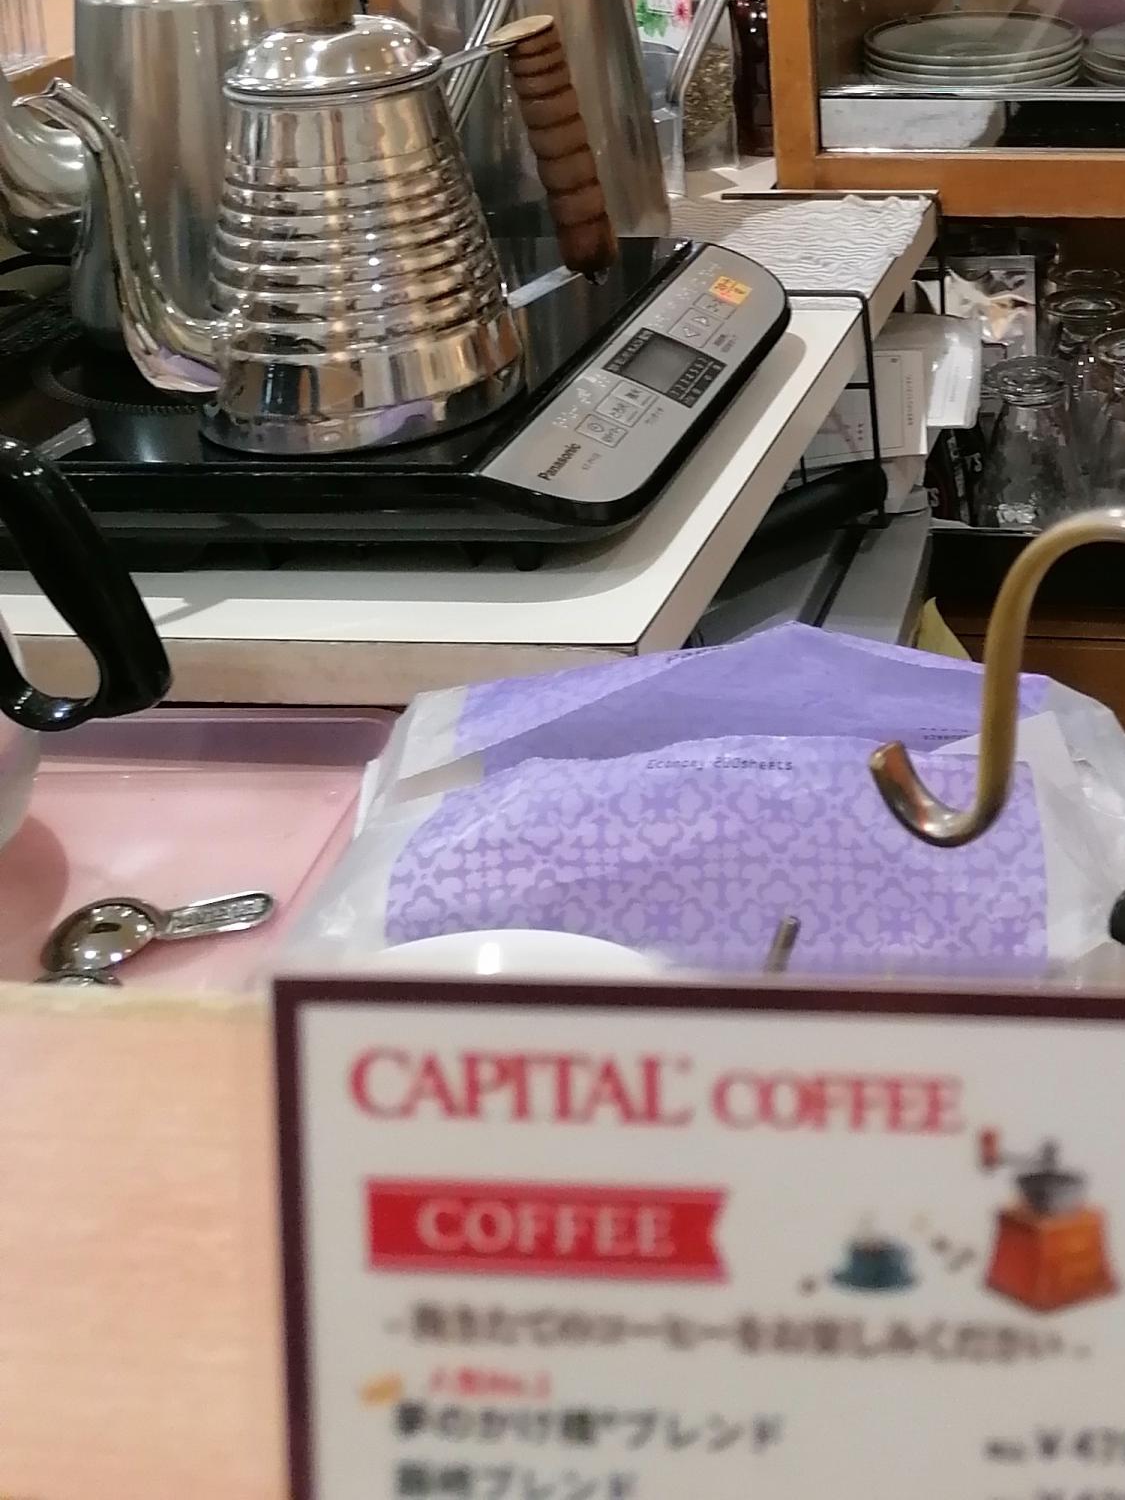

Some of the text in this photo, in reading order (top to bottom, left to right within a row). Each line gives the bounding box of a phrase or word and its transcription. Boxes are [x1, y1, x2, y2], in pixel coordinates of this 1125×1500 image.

[537, 443, 581, 481] Panasonic
[350, 1046, 967, 1136] CAPITAL COFFEE
[415, 1199, 677, 1261] COFFEE
